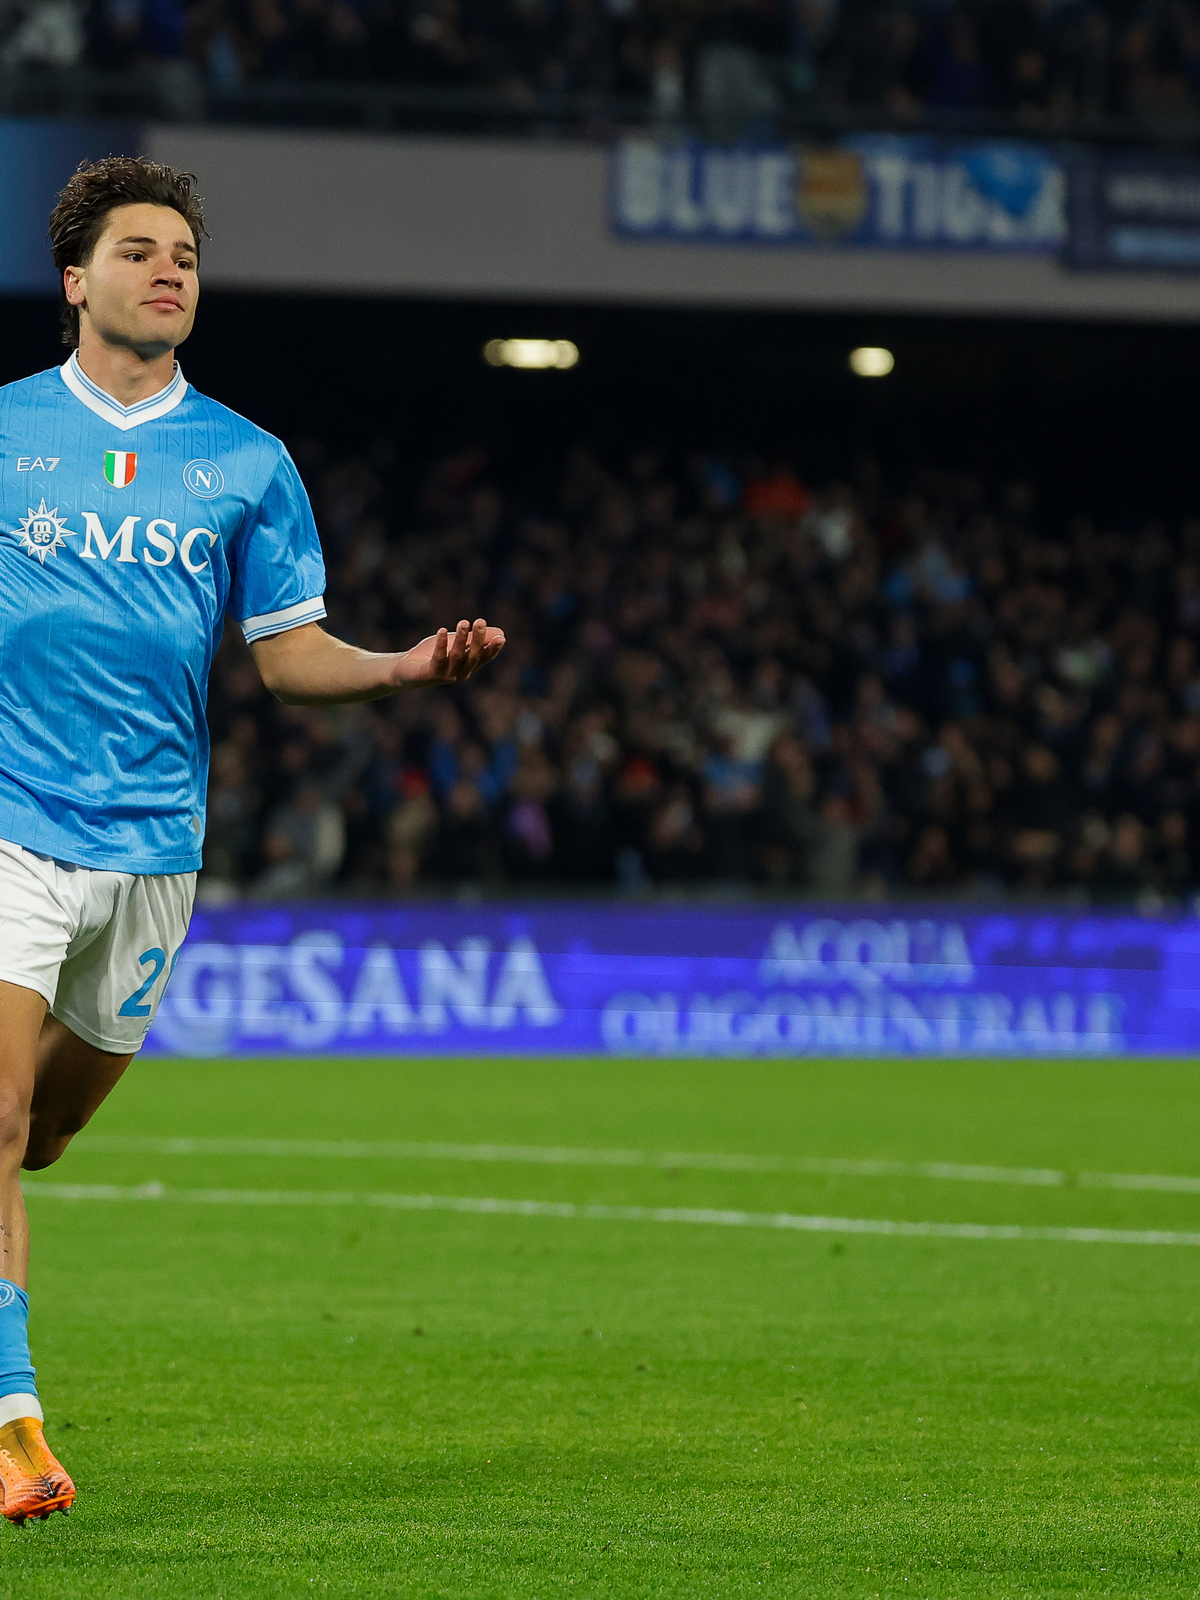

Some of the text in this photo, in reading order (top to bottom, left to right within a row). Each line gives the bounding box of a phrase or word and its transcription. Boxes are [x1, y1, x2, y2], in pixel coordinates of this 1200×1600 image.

[617, 138, 792, 238] BLUE
[16, 456, 61, 472] EA7
[194, 469, 213, 489] N
[78, 511, 219, 574] MSC
[760, 919, 974, 986] ACQUA
